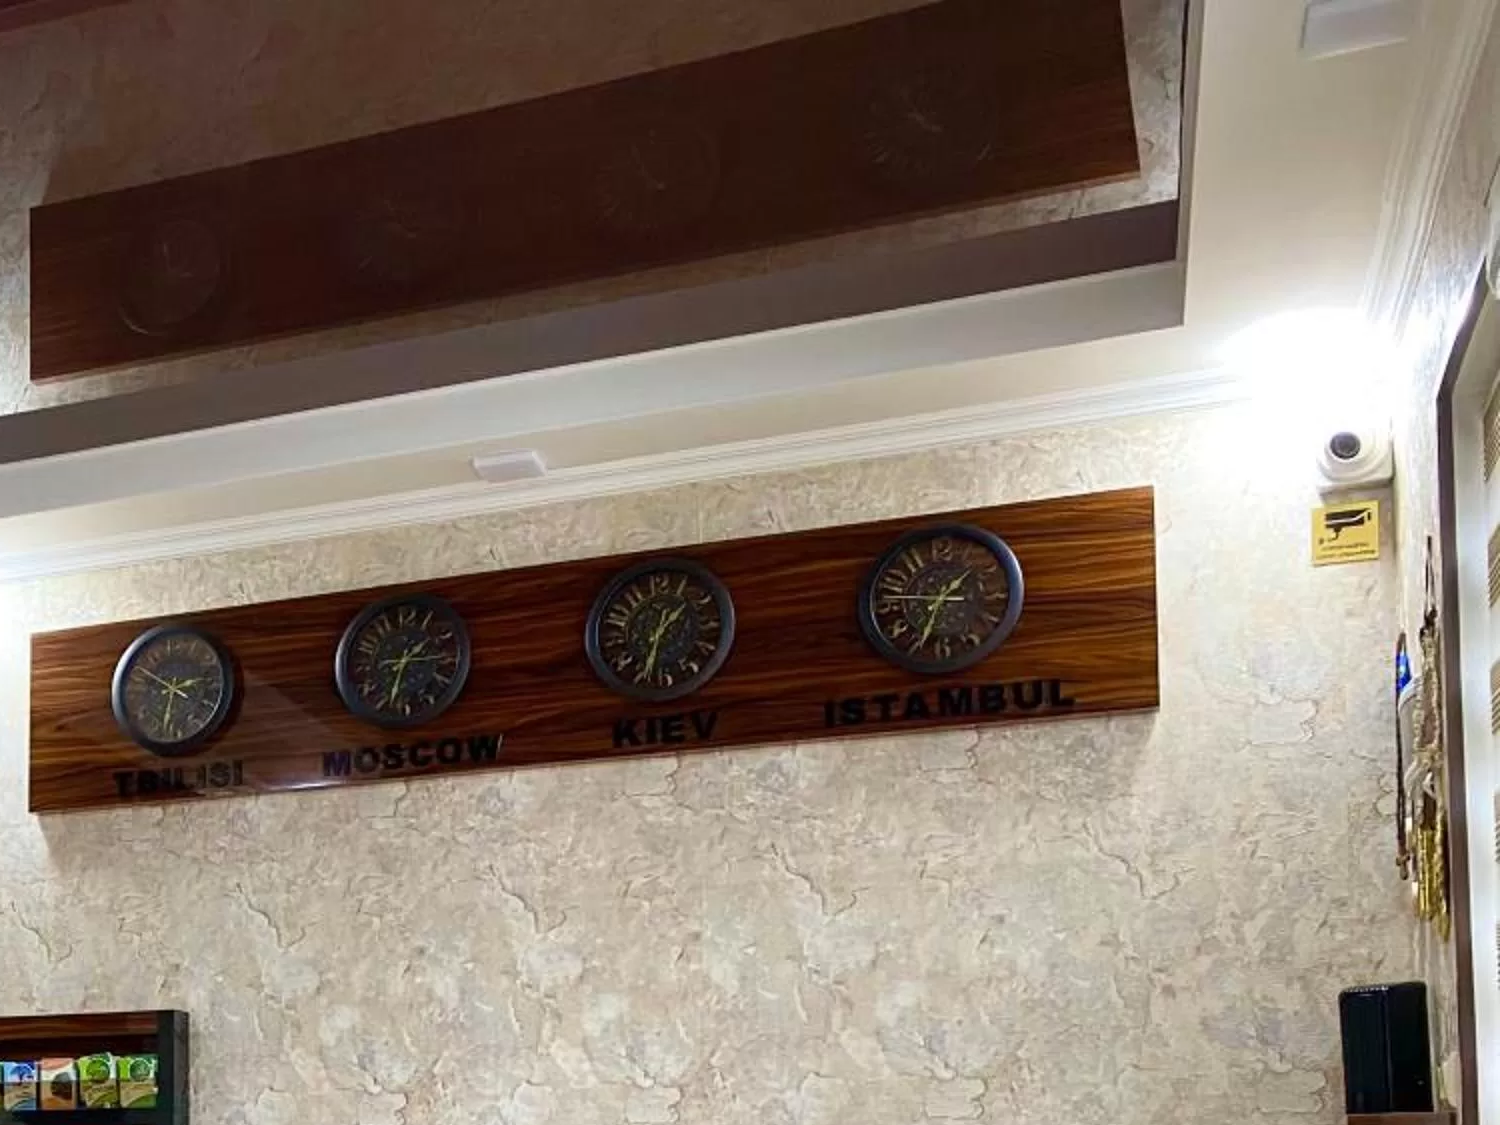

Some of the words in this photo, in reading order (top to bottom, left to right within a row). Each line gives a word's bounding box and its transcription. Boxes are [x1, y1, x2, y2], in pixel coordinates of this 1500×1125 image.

[824, 679, 1075, 729] ISTAMBUL
[612, 711, 719, 748] KIEV
[322, 734, 504, 777] MOSCOW
[112, 760, 243, 798] TBILISI
